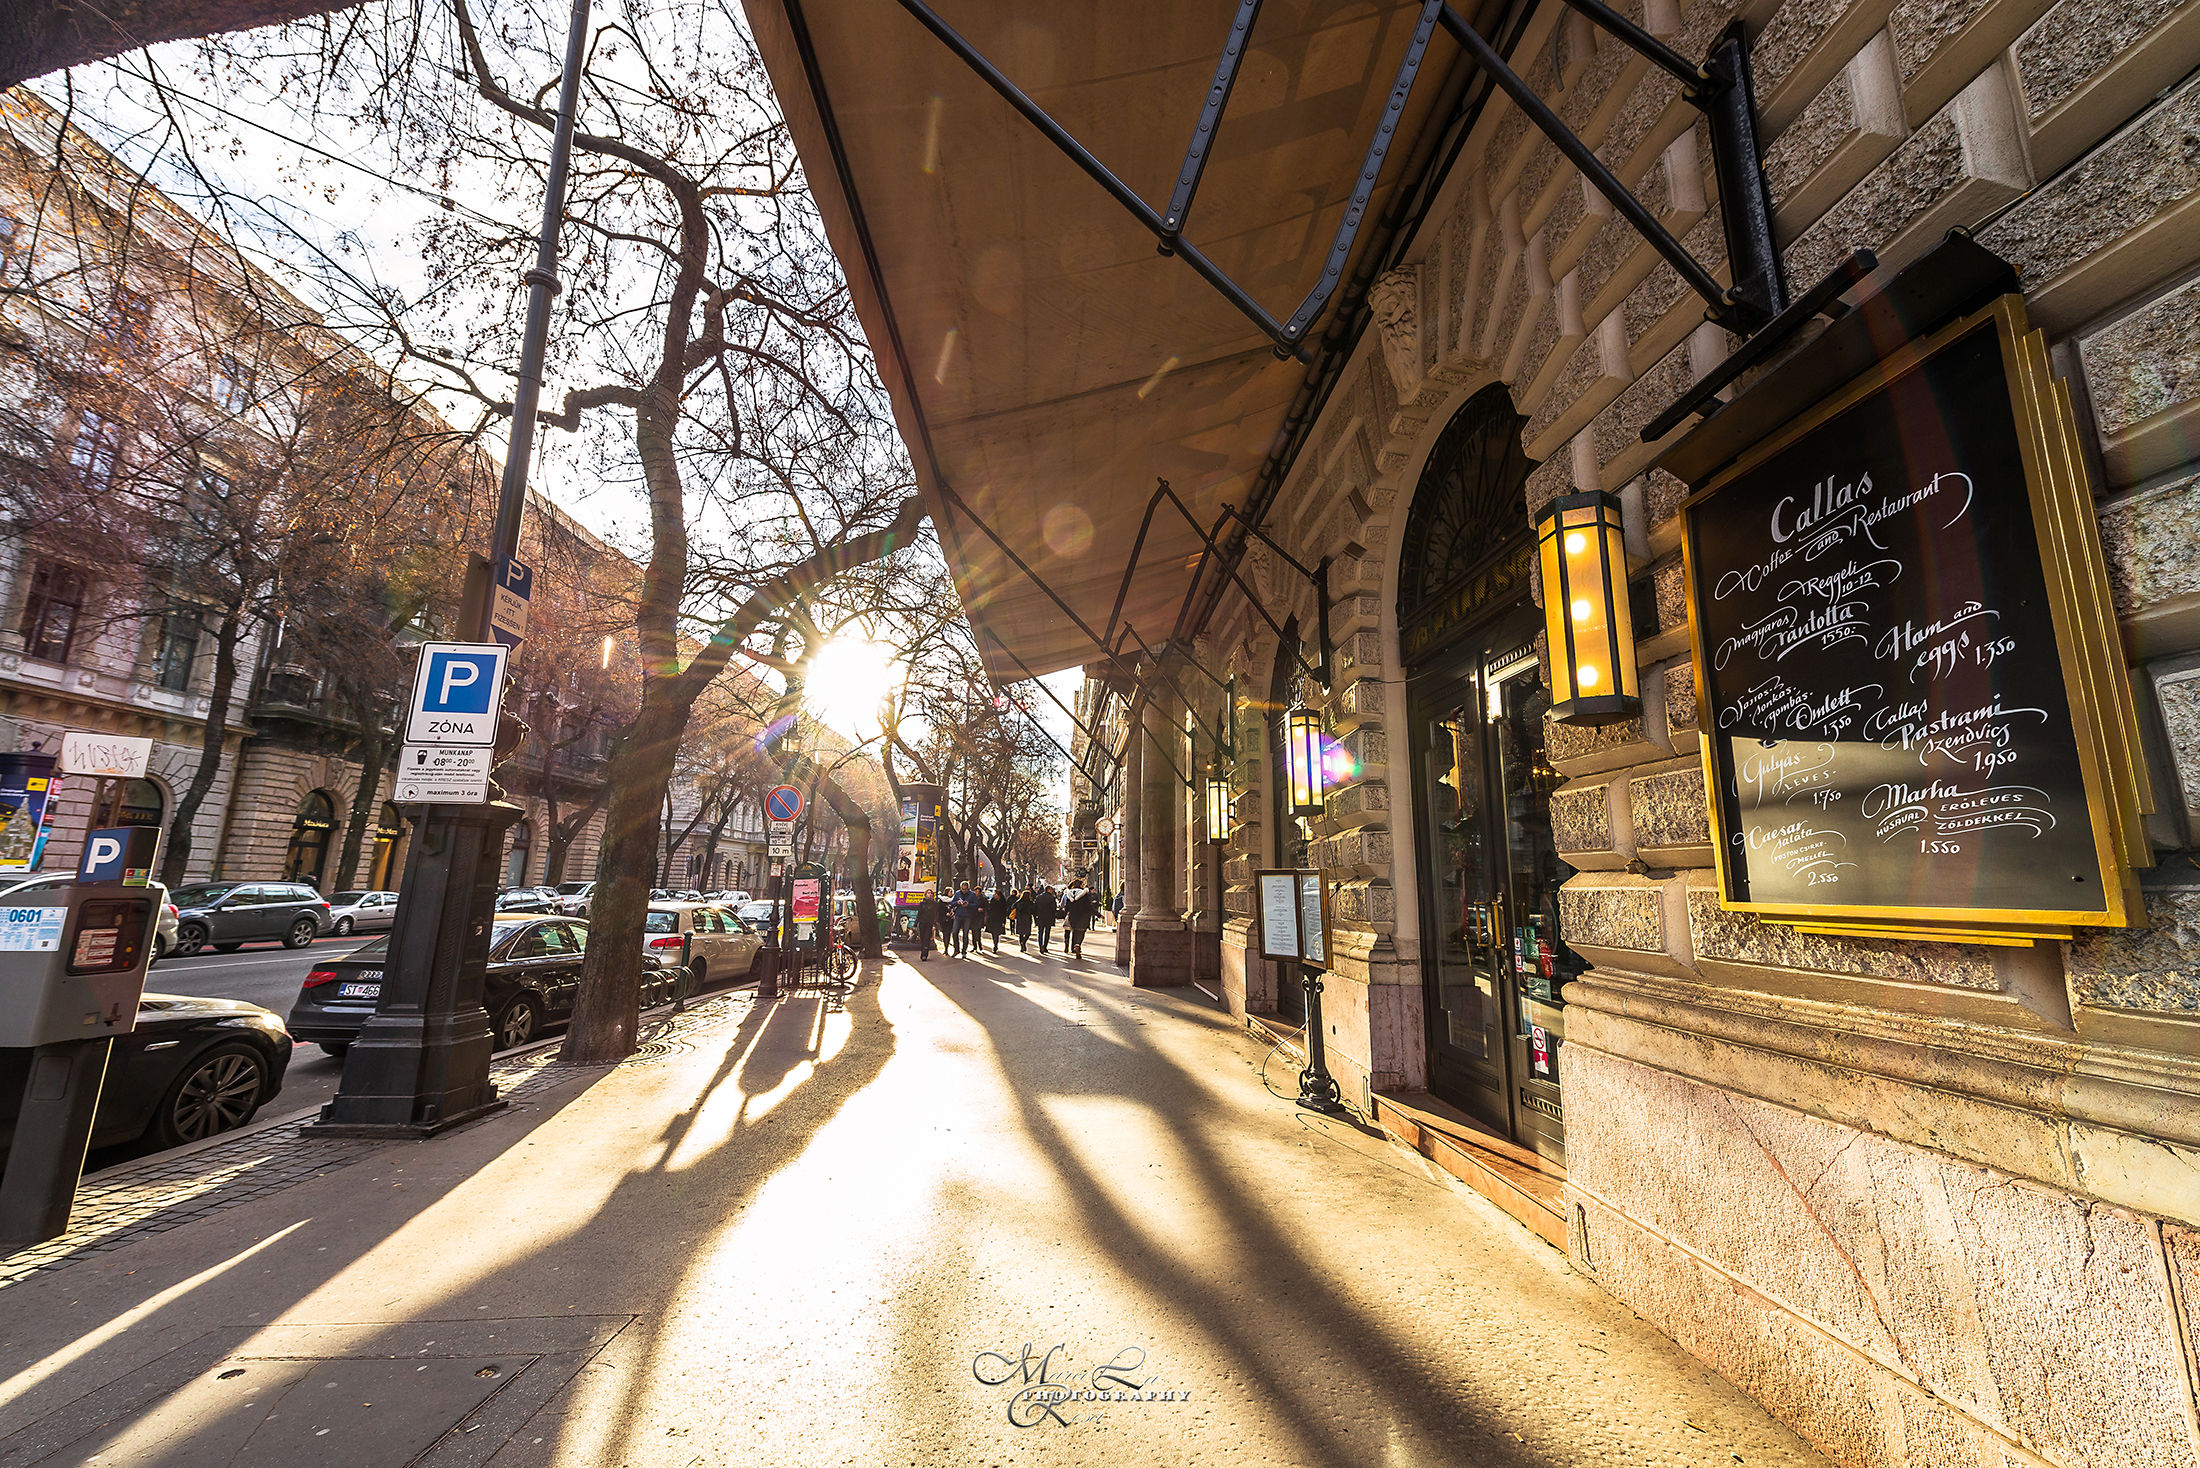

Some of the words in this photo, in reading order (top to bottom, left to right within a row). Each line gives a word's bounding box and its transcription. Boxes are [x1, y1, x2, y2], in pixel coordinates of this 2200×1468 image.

[1770, 471, 1873, 543] Callas
[1722, 549, 1794, 598] Coffee
[1853, 472, 1973, 549] Restaurant
[506, 559, 525, 587] P
[1790, 560, 1880, 603] Reggeli
[1841, 572, 1873, 594] 10-12
[1876, 617, 1952, 661] Ham
[1953, 600, 1983, 619] and
[1911, 630, 1970, 683] eggs
[1975, 636, 2016, 670] 1.350
[438, 660, 480, 705] P
[1787, 686, 1858, 730] Omlett
[1890, 694, 2010, 750] Pastrami
[428, 719, 474, 734] ZÓNA
[1823, 714, 1852, 743] 1.350
[1973, 748, 2017, 780] 1.950
[1813, 789, 1842, 811] 1.750
[1872, 779, 1966, 813] Marha
[1740, 820, 1807, 851] Caesar
[1921, 839, 1961, 853] 1.550
[85, 837, 121, 874] P
[1807, 871, 1839, 887] 2.550
[9, 909, 42, 922] 0601
[346, 985, 359, 995] ST
